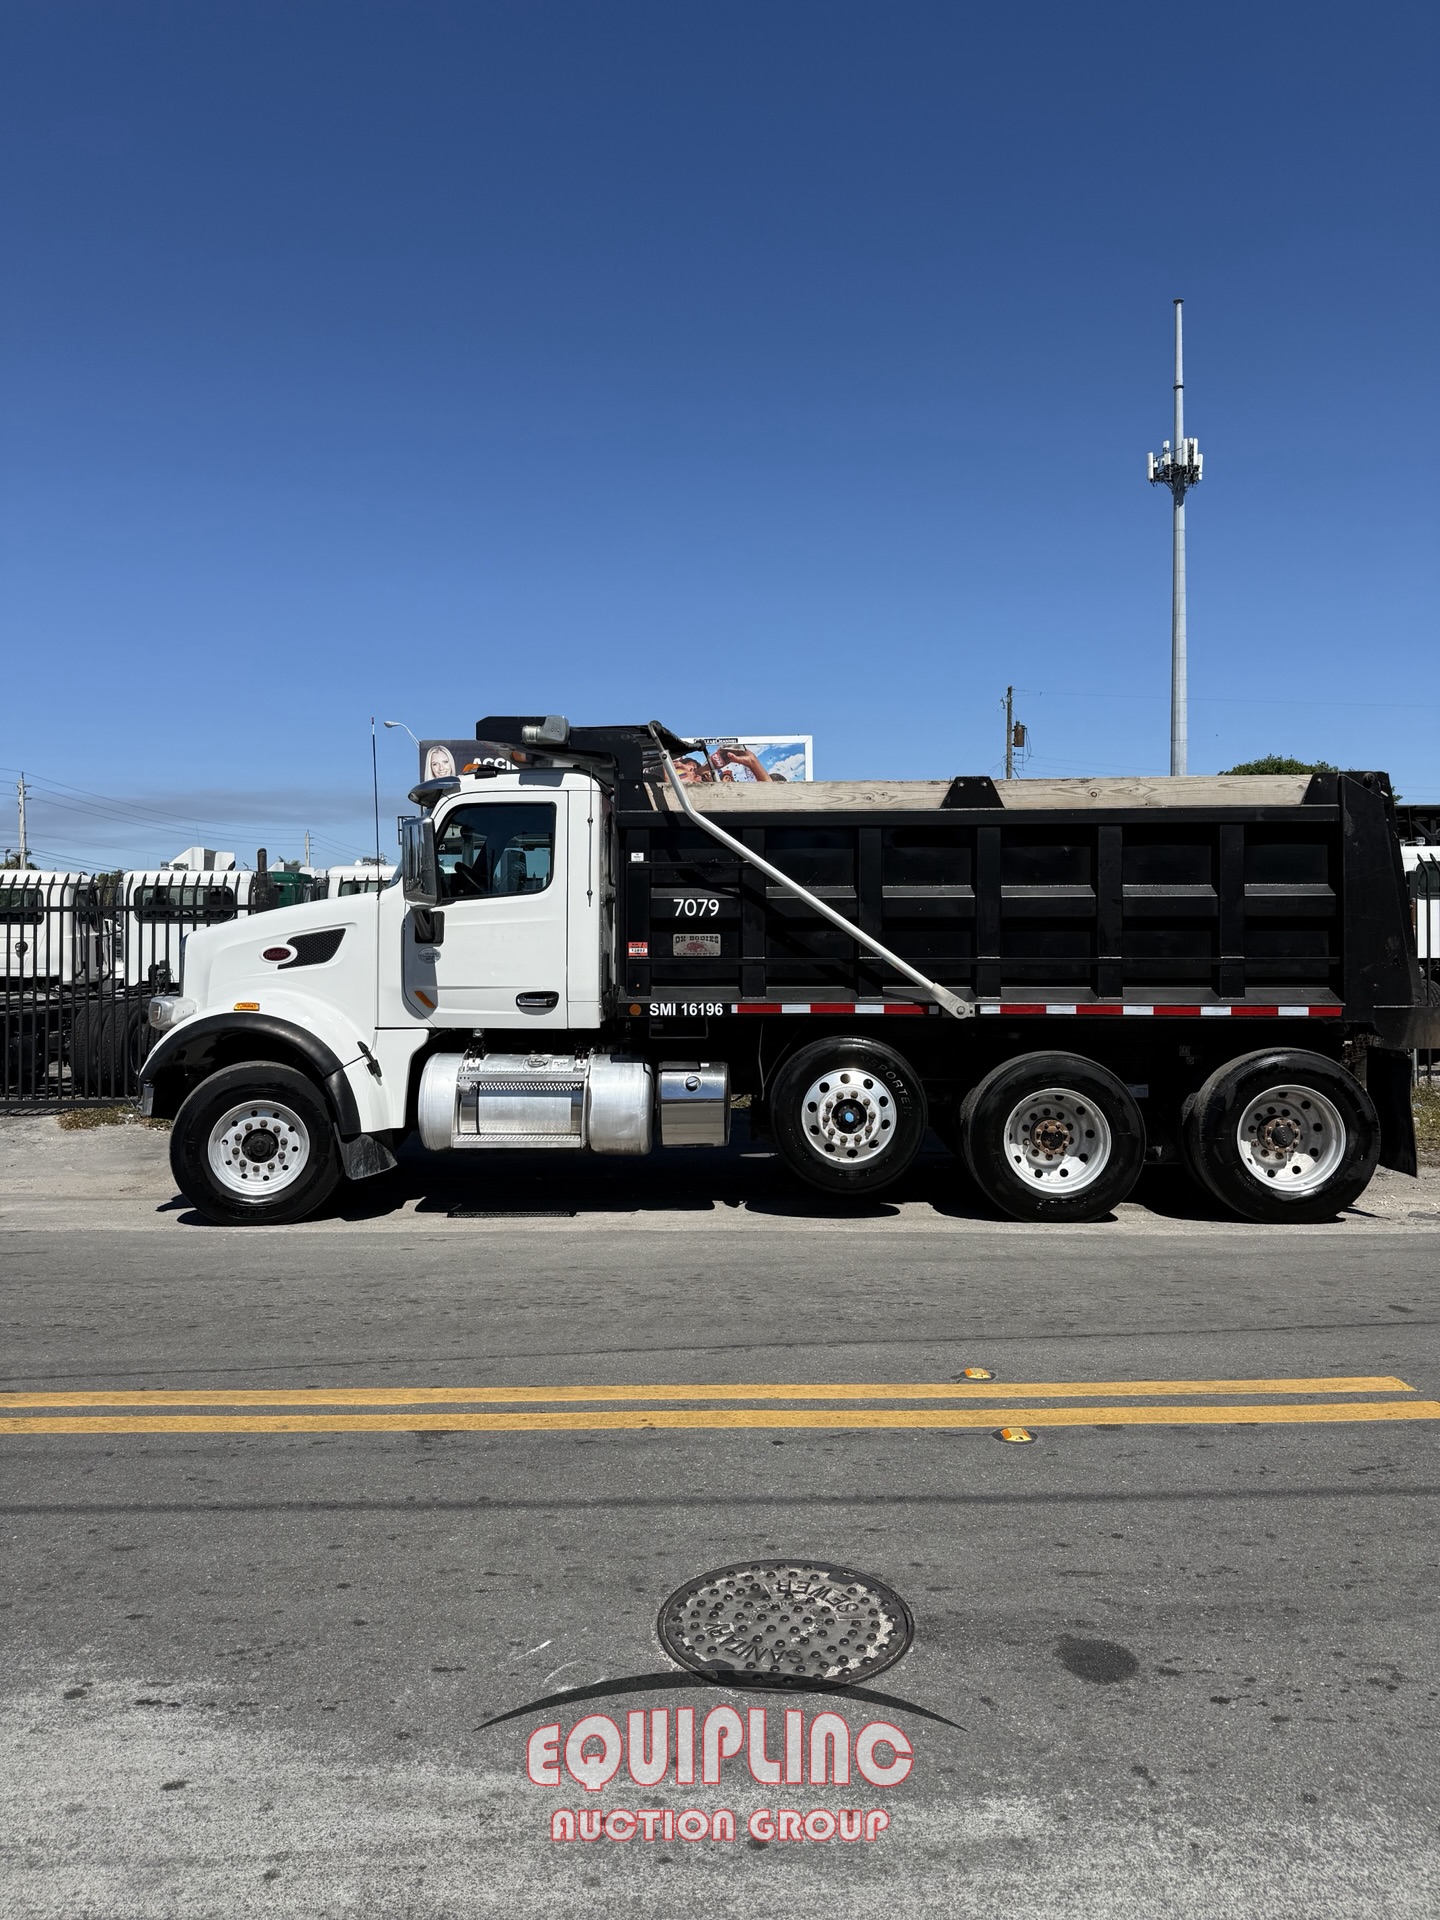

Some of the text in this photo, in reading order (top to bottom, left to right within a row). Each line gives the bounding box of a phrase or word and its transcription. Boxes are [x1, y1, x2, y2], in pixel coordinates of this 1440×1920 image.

[673, 899, 720, 917] 7079
[649, 1003, 724, 1016] SMI 16196
[704, 1579, 859, 1664] SANITARY SEWER
